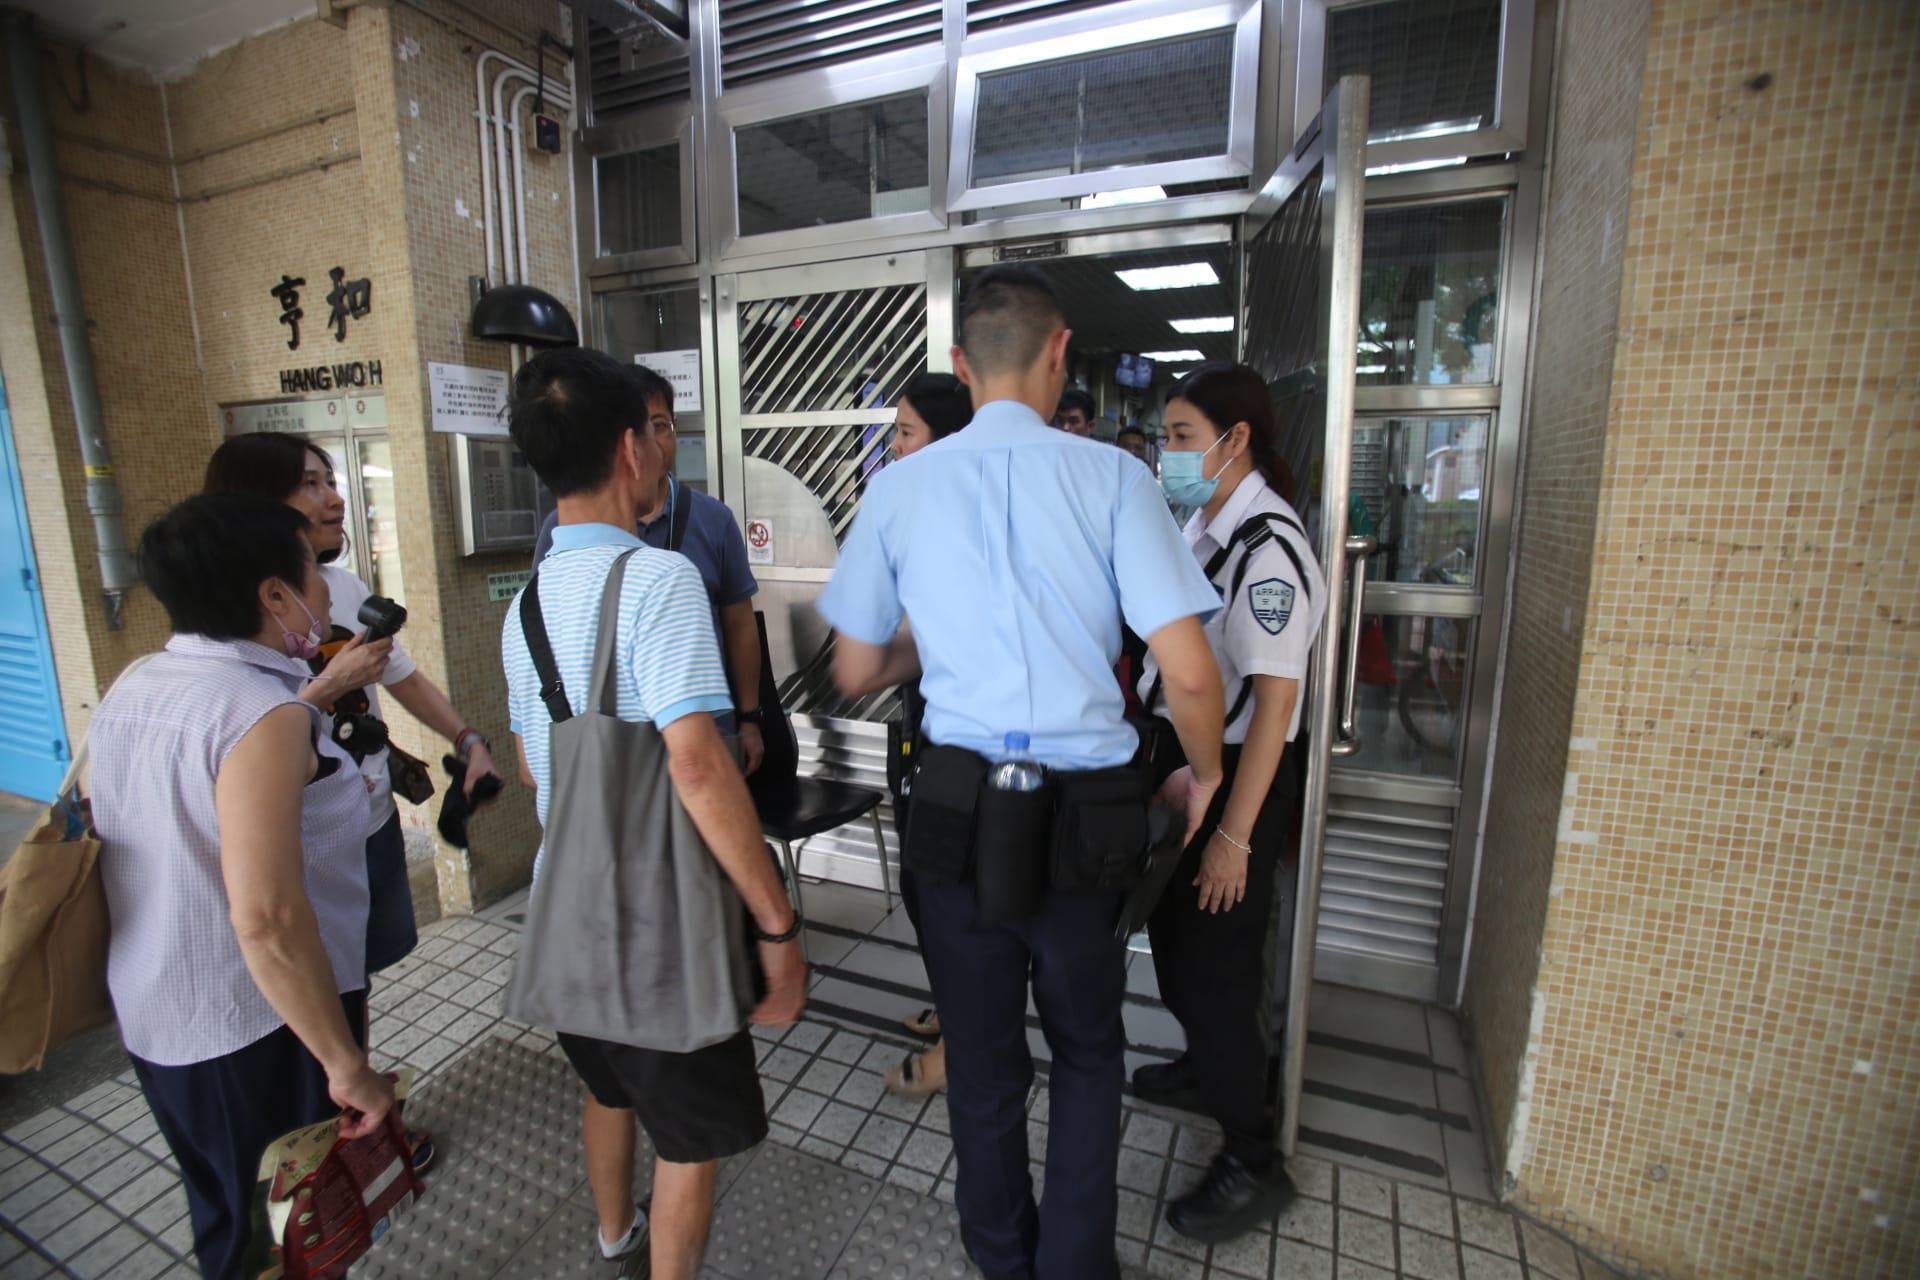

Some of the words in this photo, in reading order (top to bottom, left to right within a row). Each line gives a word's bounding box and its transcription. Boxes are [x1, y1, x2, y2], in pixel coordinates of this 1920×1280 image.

[270, 265, 371, 351] 亨和
[280, 366, 332, 393] HANG
[332, 361, 366, 388] WO
